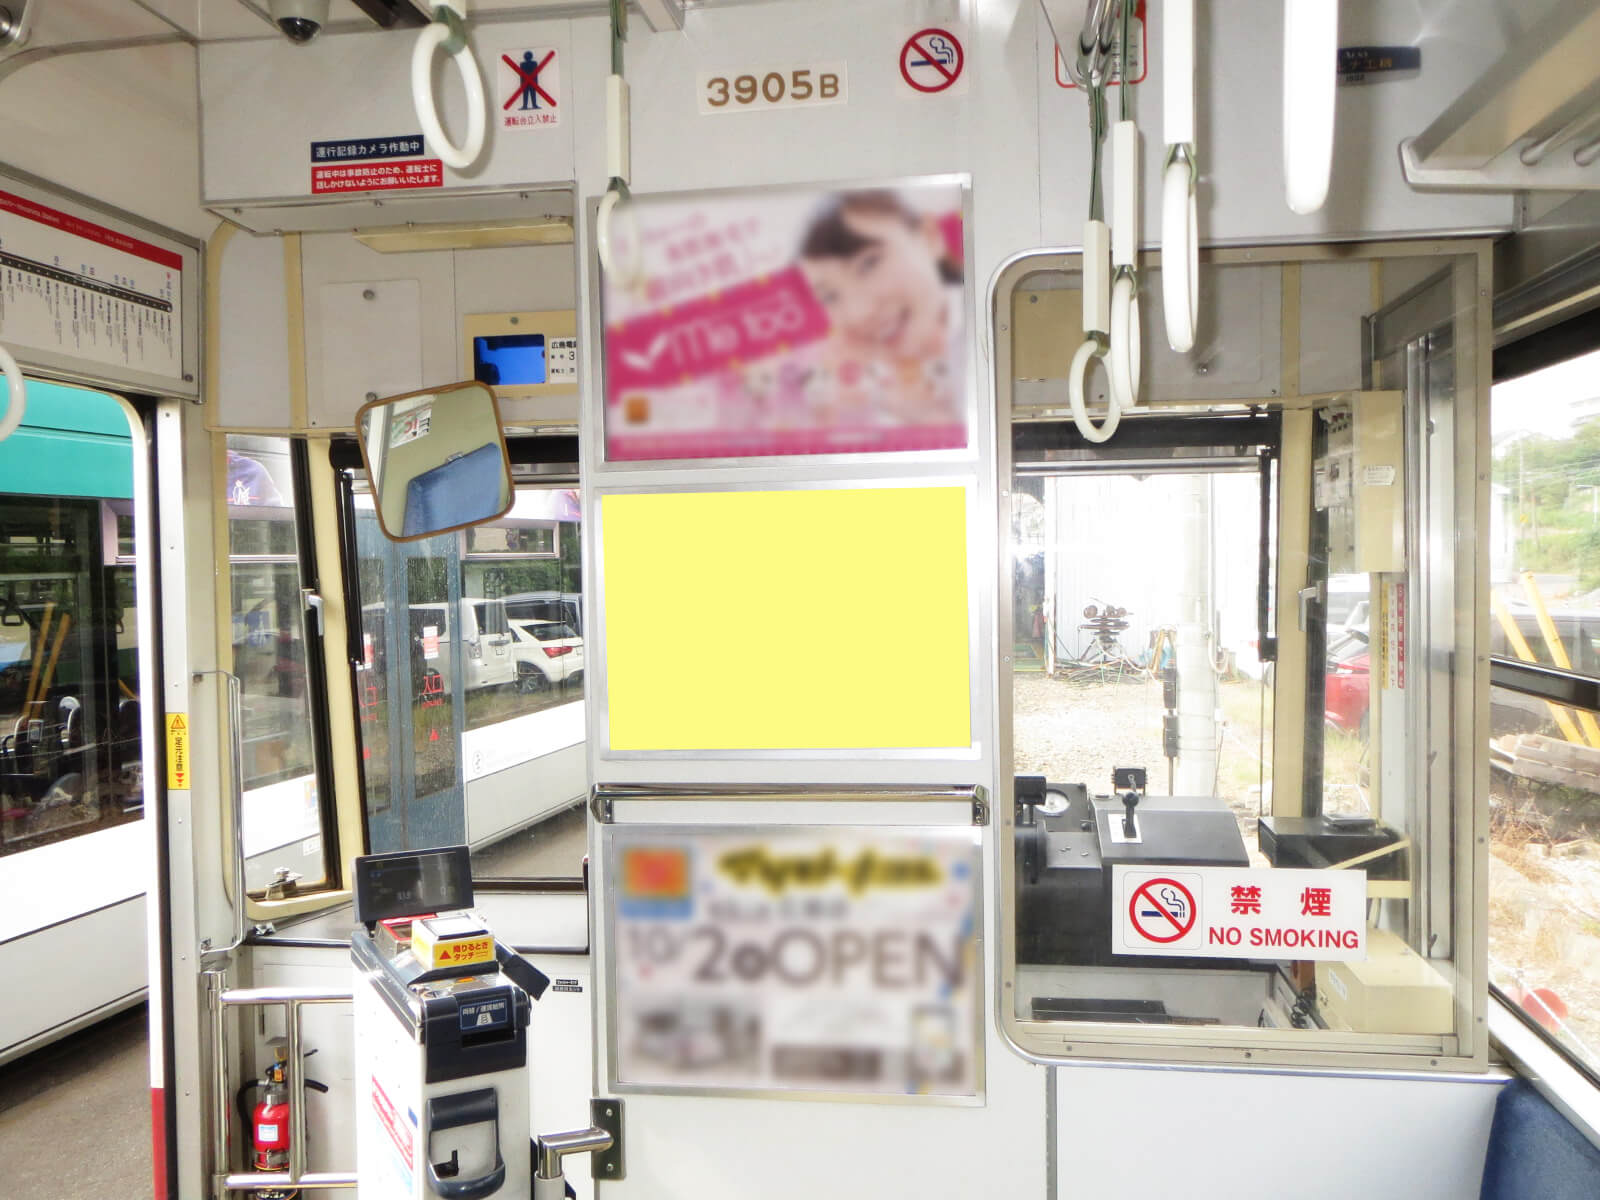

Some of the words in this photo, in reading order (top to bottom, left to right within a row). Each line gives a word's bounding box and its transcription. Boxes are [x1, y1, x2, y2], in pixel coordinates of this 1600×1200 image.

[707, 69, 839, 107] 3905B
[316, 141, 420, 158] 運行記録カメラ作動中
[1208, 926, 1242, 946] NO
[1249, 927, 1359, 950] SMOKING
[453, 941, 489, 953] 降りるとき
[454, 951, 475, 961] タッチ
